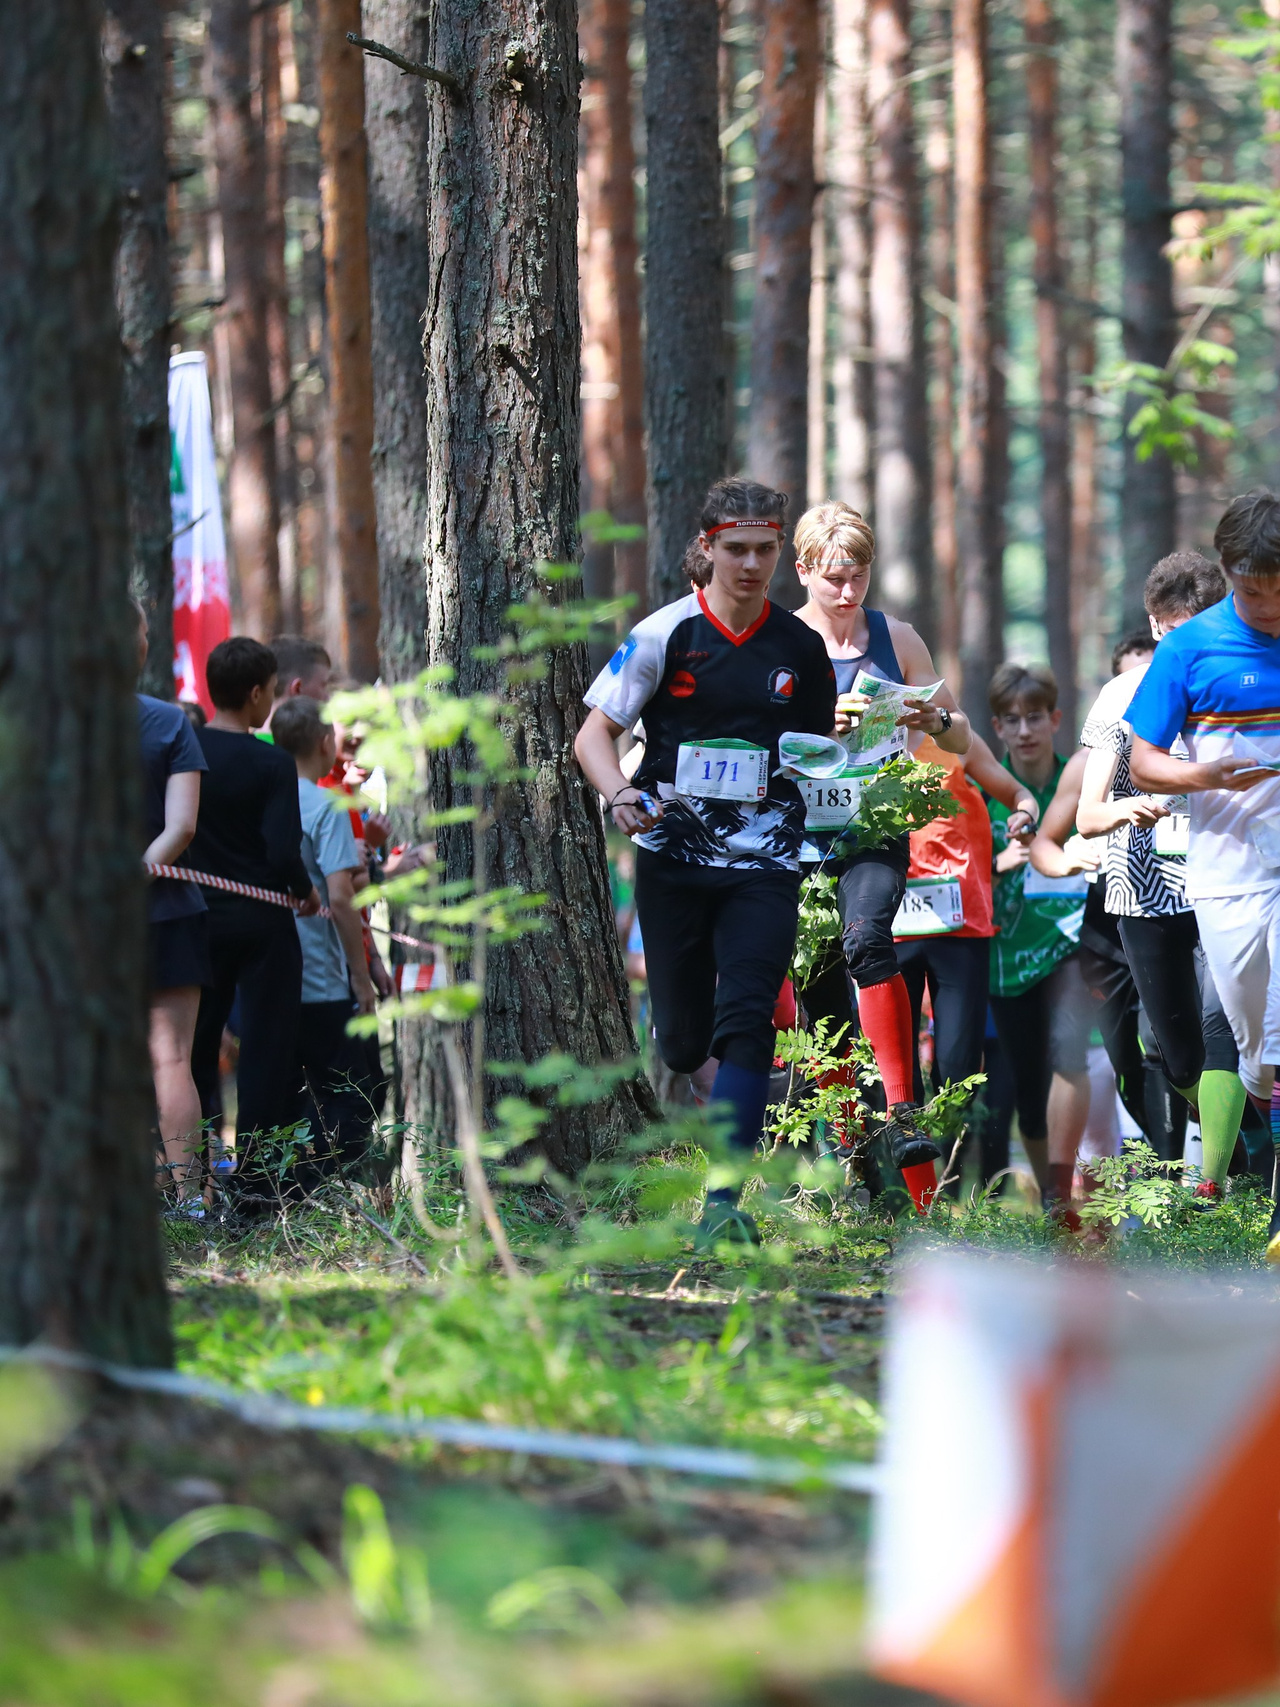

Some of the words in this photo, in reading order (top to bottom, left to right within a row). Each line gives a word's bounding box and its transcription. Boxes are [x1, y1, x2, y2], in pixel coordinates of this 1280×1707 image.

[1243, 674, 1255, 685] n
[701, 760, 739, 782] 171
[815, 788, 852, 807] 183
[903, 895, 934, 914] 185
